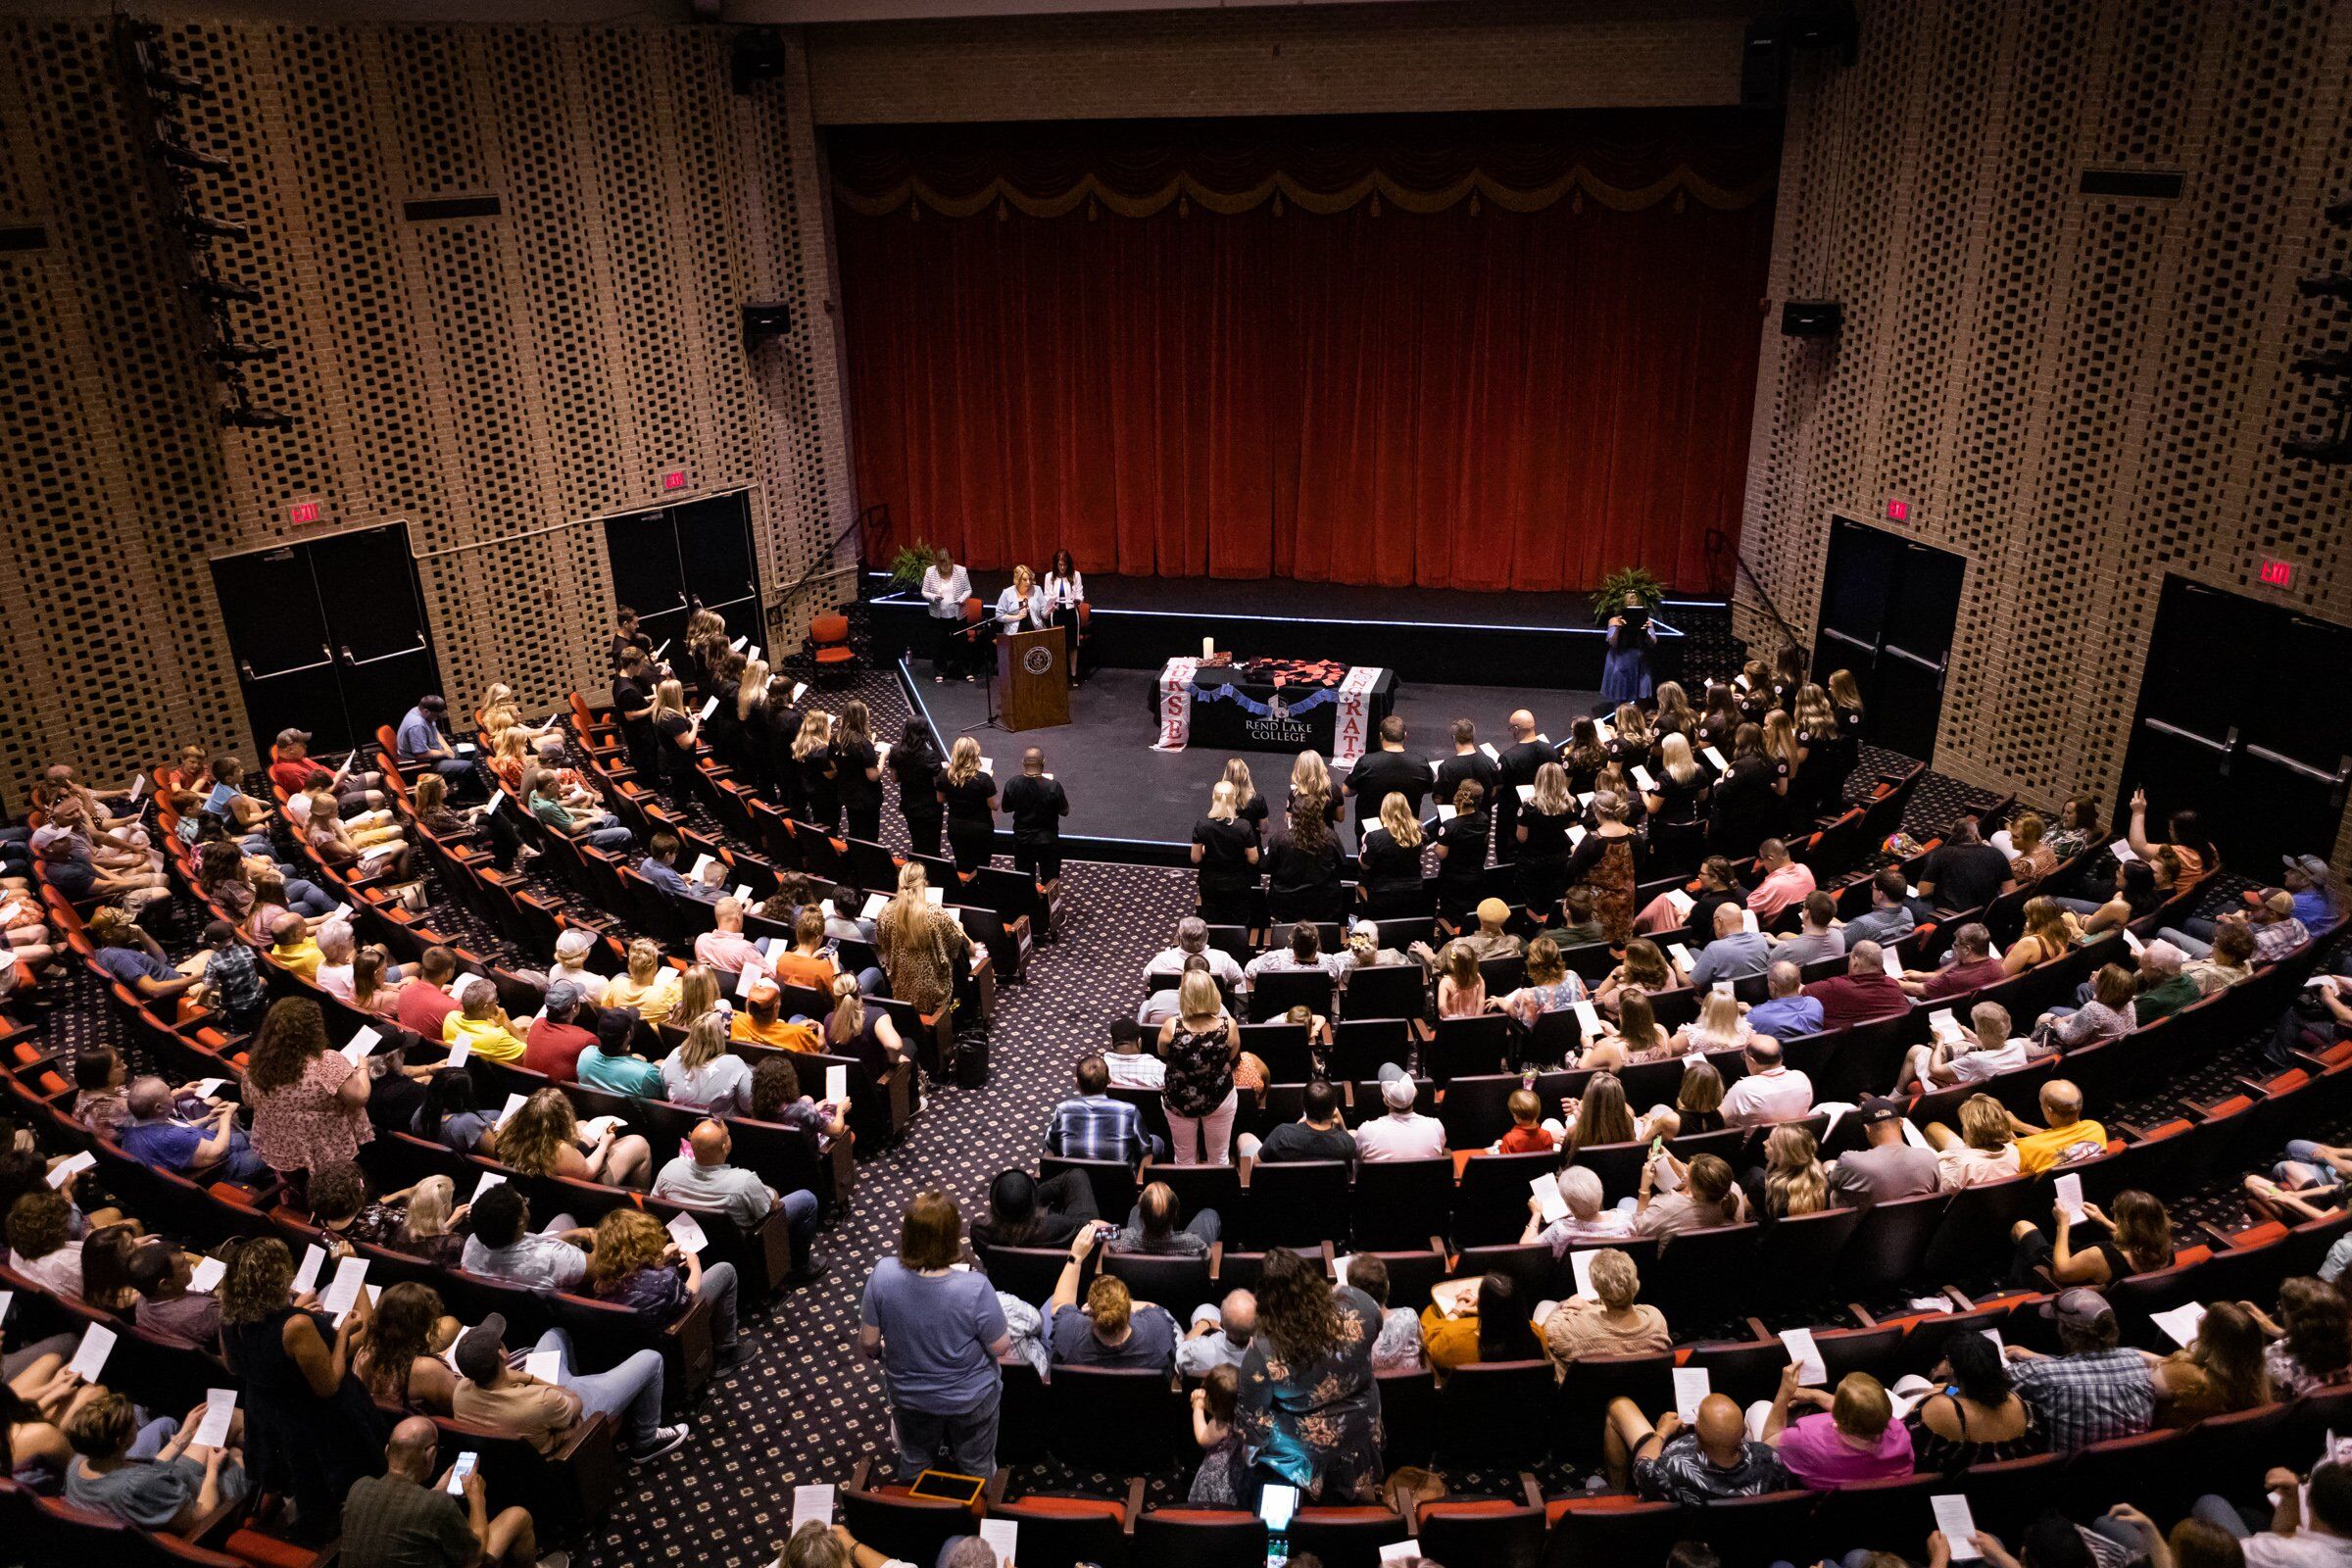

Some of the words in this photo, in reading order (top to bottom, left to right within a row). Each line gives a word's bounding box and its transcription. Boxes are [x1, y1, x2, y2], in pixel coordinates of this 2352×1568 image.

[1246, 719, 1279, 731] REND
[1282, 721, 1312, 733] LAKE
[1251, 730, 1306, 743] COLLEGE
